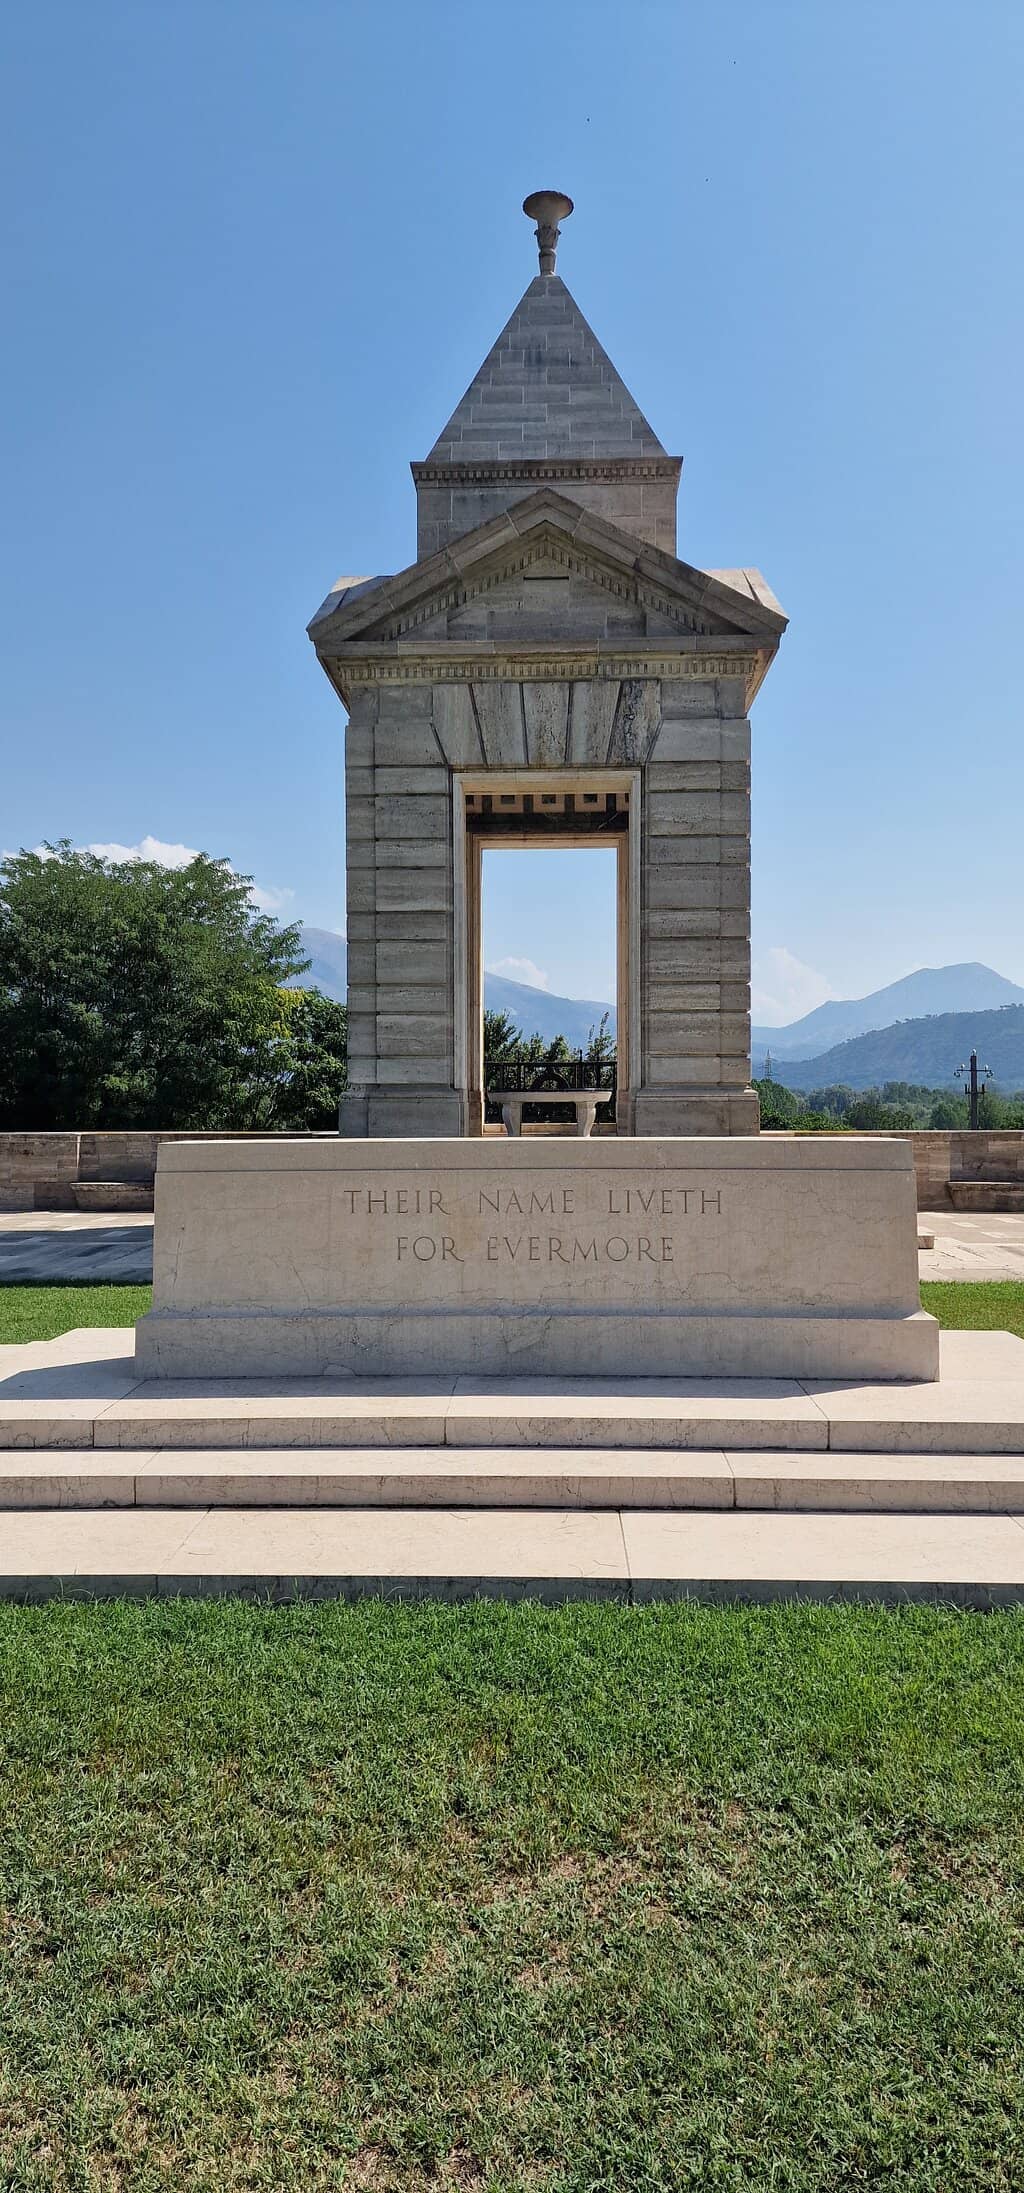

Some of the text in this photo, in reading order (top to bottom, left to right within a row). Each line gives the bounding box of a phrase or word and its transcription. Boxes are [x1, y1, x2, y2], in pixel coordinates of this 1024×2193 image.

[344, 1189, 722, 1215] THEIR NAME LIVETH
[397, 1236, 674, 1263] FOR EVERMORE
